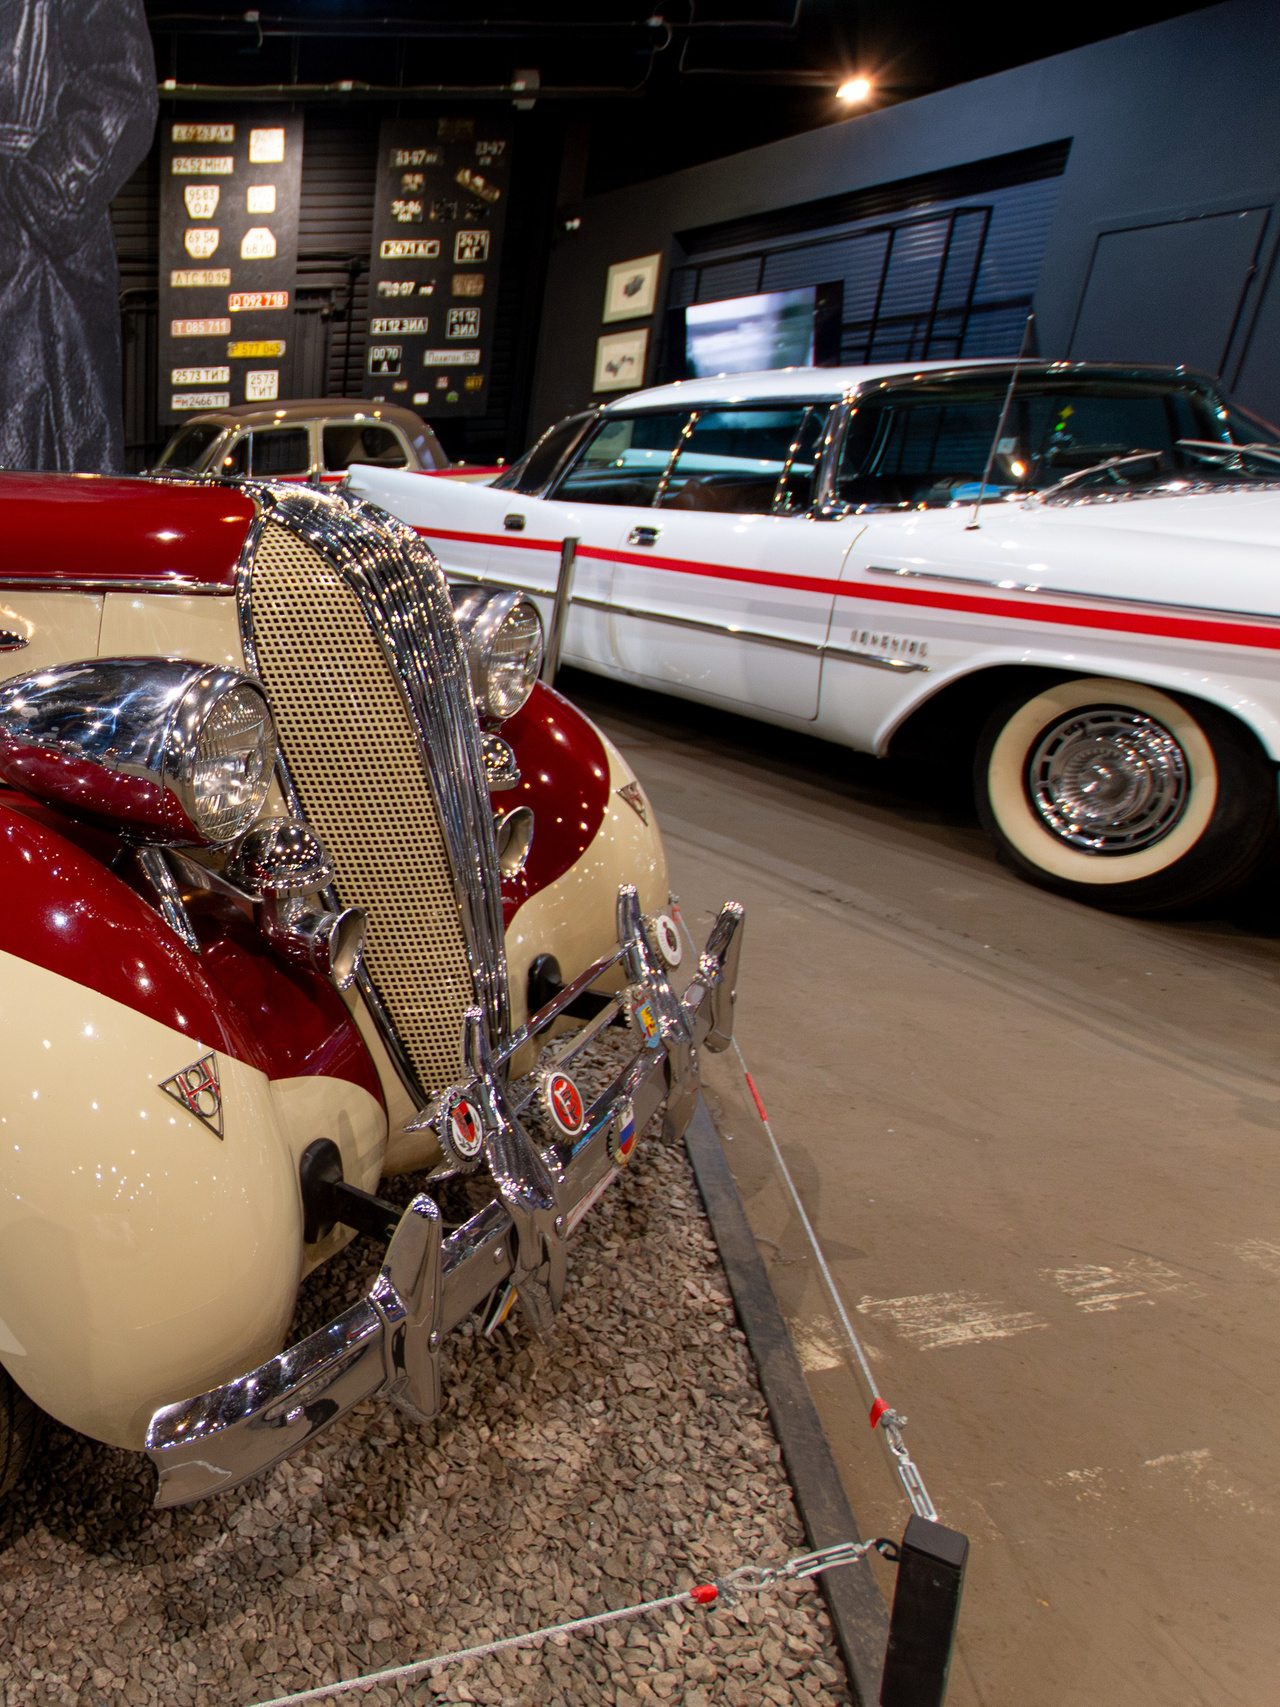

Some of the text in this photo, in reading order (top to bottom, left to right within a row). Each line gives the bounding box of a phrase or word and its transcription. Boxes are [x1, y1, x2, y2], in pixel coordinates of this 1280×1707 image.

[175, 368, 226, 381] 2573 ТИТ
[250, 374, 275, 385] 2573
[251, 386, 275, 397] ТИТ
